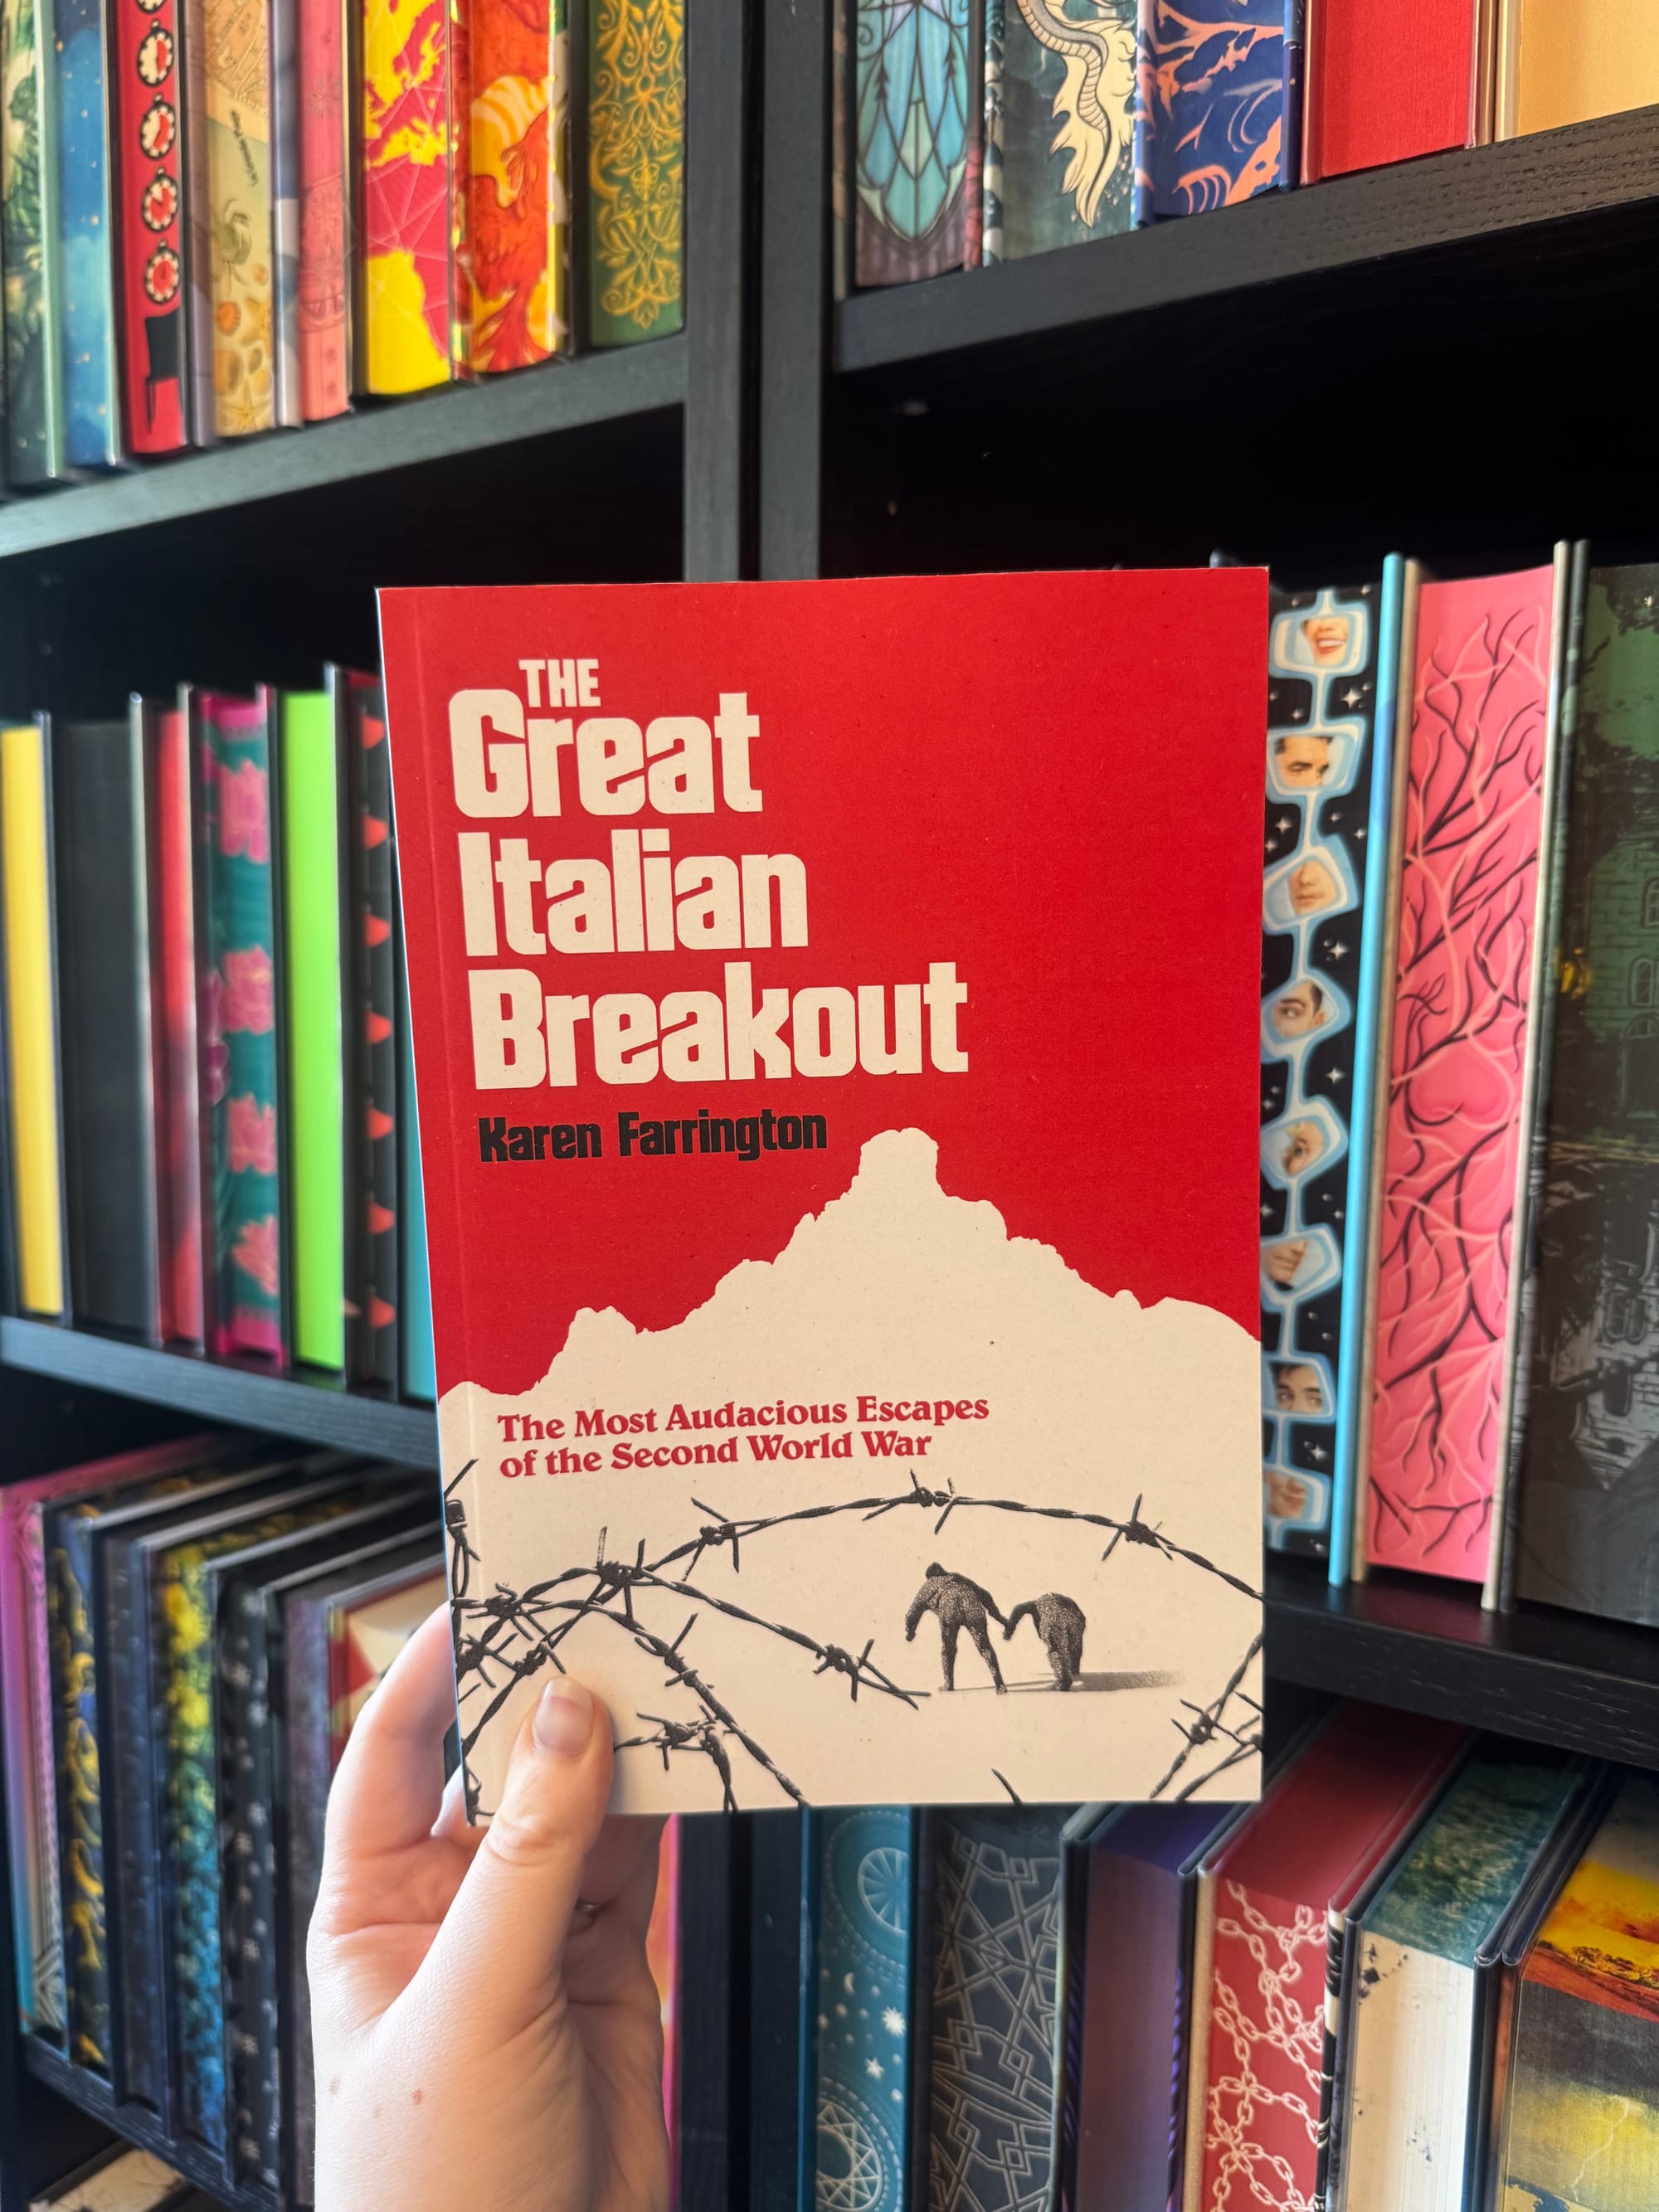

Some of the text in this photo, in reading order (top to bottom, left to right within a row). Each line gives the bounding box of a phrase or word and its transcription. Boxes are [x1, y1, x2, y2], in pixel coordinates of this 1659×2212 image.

[519, 659, 601, 707] THE
[449, 689, 763, 818] Great
[458, 829, 808, 956] Italian
[469, 962, 969, 1090] Breakout
[479, 1109, 827, 1163] Karen Farrington
[498, 1395, 990, 1442] The Most Audacious Escapes
[499, 1430, 932, 1478] of the Second World War
